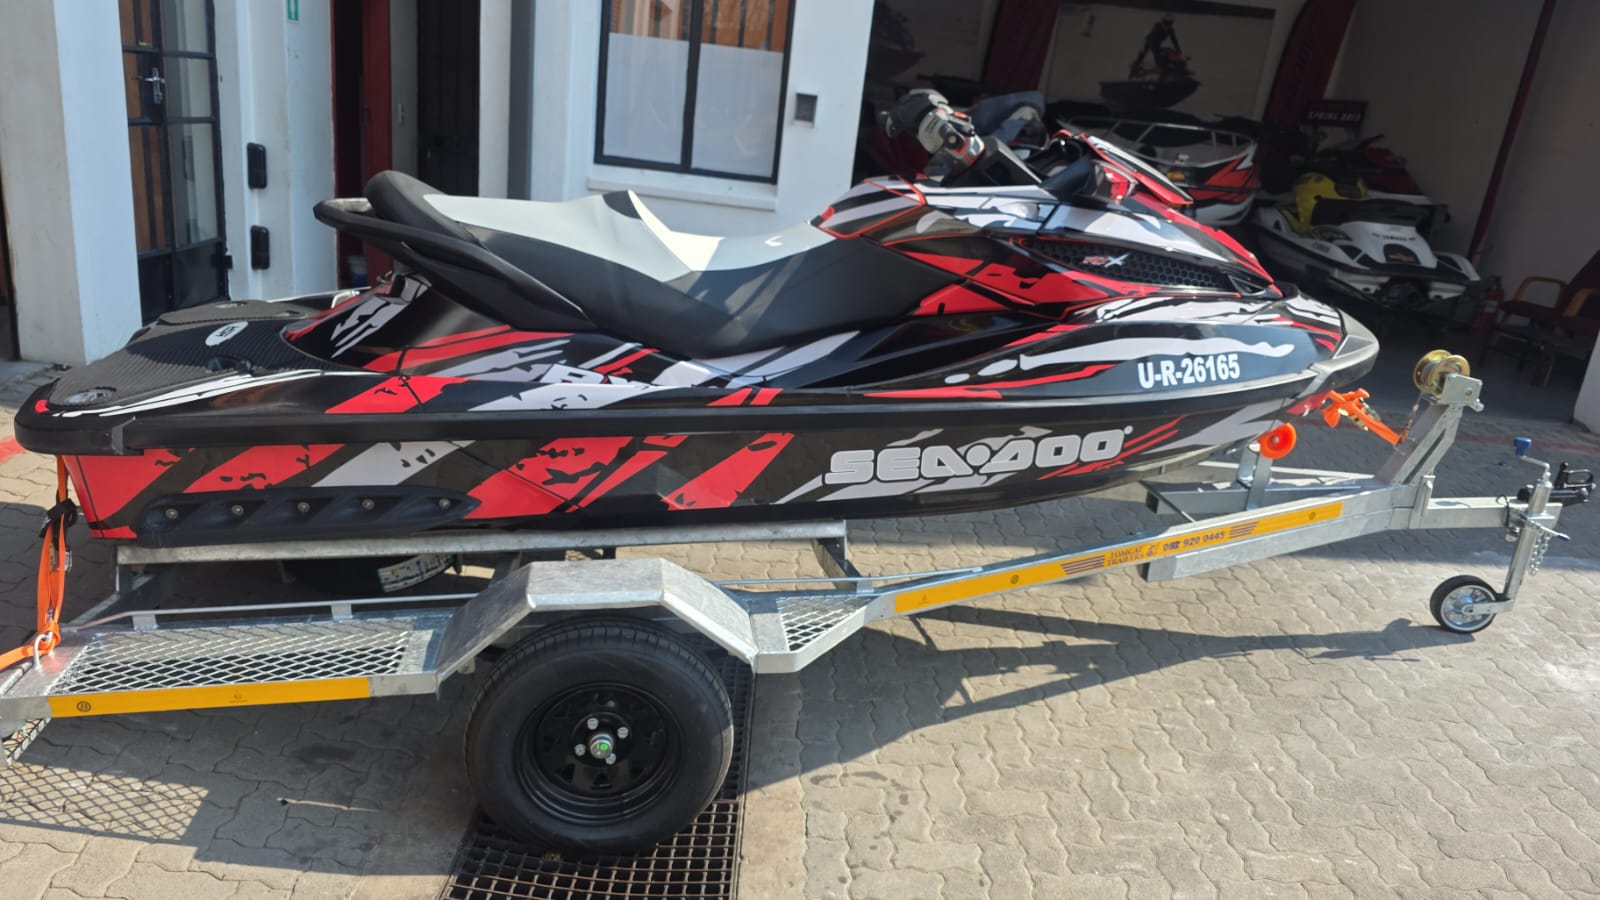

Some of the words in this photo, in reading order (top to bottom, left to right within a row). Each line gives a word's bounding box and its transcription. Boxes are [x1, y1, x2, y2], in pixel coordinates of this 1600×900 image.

[1137, 353, 1241, 389] U-R-26165
[1163, 541, 1181, 551] 082
[1183, 536, 1201, 546] 920
[1203, 530, 1225, 543] 0445
[1107, 554, 1145, 566] TRAILERS
[1111, 545, 1142, 558] TOMCAT
